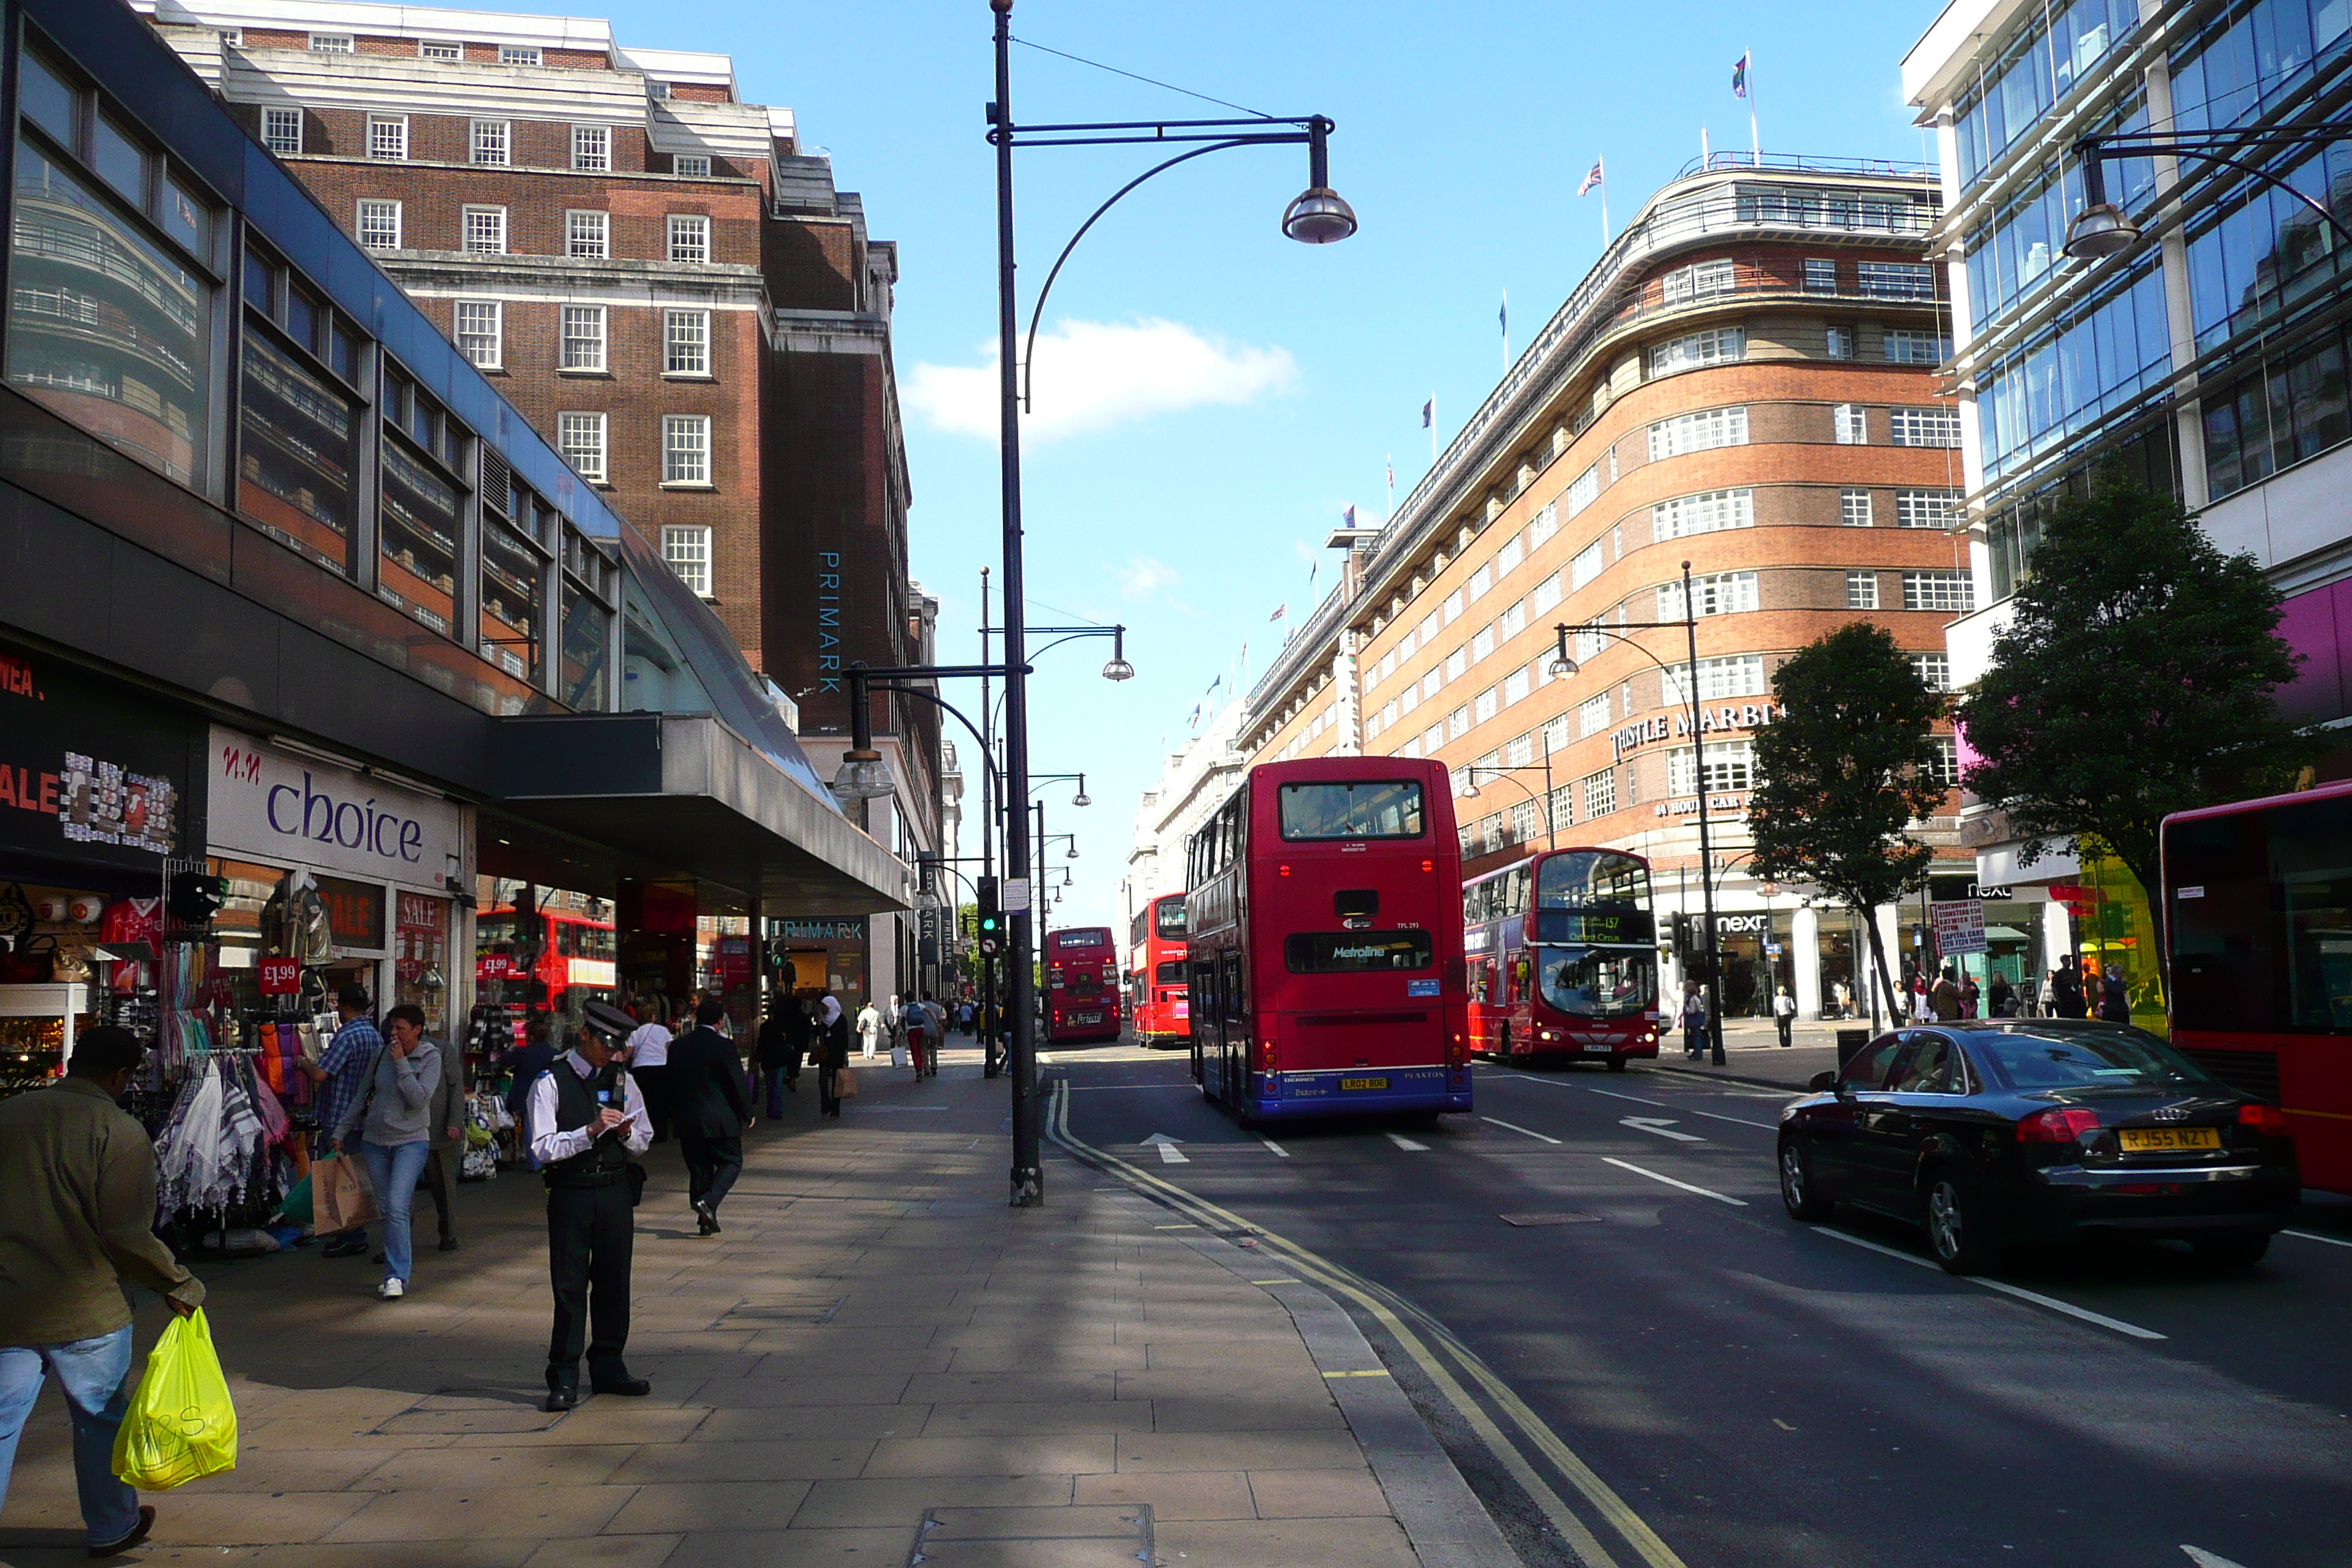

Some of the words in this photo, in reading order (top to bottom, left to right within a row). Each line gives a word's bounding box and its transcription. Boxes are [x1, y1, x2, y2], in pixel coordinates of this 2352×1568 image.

[819, 552, 840, 693] PRIMARK
[1609, 715, 1667, 761] THISTLE
[1654, 804, 1667, 815] 24
[1710, 796, 1738, 808] CAR
[404, 890, 434, 927] SALE
[1938, 902, 1969, 911] HEATHROW
[1605, 917, 1619, 929] 137
[1716, 914, 1767, 932] next
[1940, 916, 1968, 925] GATWICK
[943, 919, 952, 965] PRIMARK
[1569, 932, 1596, 941] Oxford
[1597, 933, 1620, 942] Circus
[1942, 931, 1967, 940] CAPITAL
[1333, 946, 1385, 959] Metroline
[484, 959, 507, 973] £1.99
[264, 965, 296, 987] £1.99
[1369, 1079, 1384, 1088] BDE
[2127, 1131, 2174, 1147] RJ55
[2179, 1130, 2209, 1146] NZT
